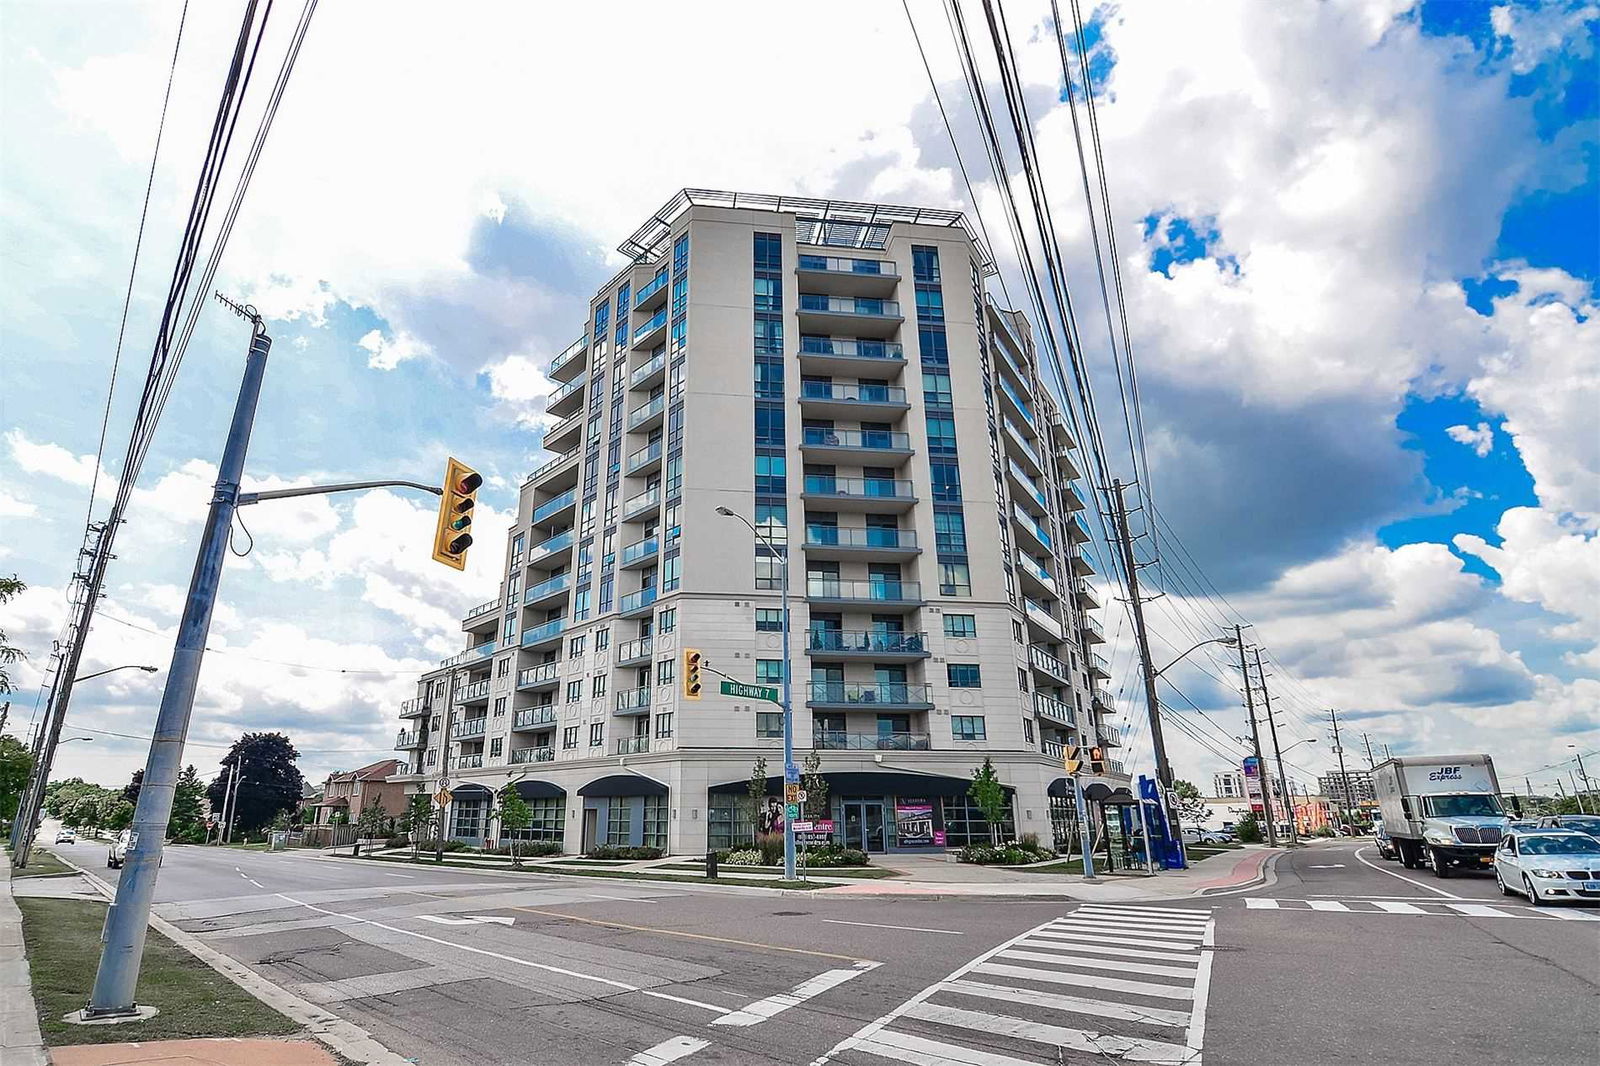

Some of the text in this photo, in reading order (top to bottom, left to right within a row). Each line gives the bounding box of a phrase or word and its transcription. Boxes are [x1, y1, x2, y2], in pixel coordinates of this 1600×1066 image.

[730, 684, 770, 698] HIGHWAY 7
[1437, 766, 1461, 775] JBF
[1429, 772, 1462, 781] Express
[787, 785, 797, 793] NO
[813, 823, 832, 831] entre
